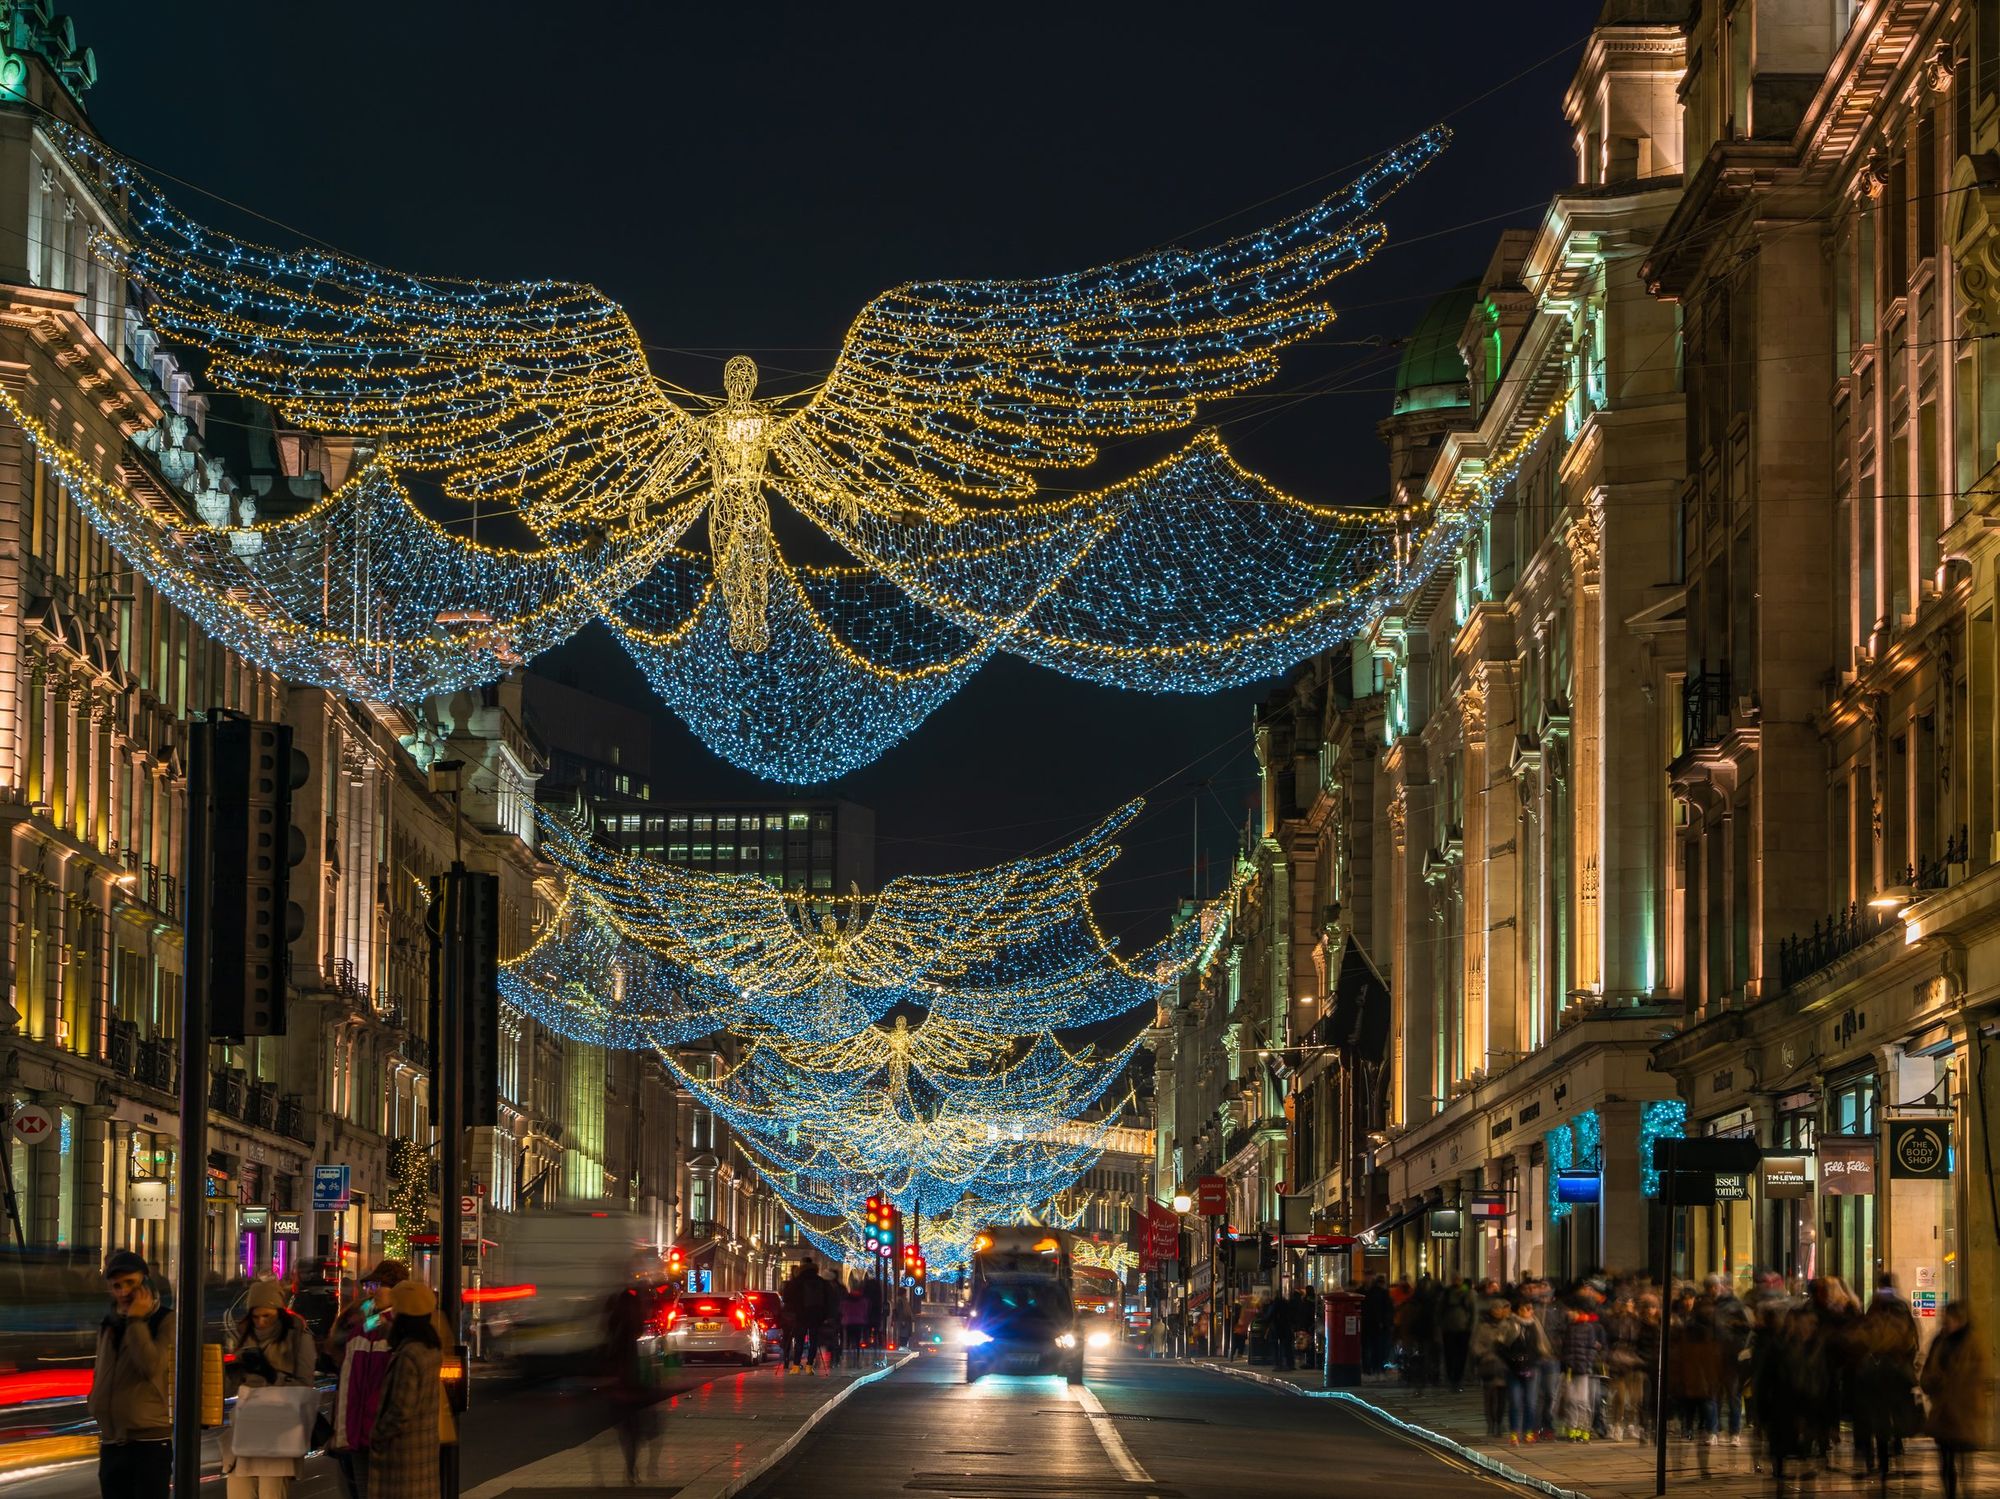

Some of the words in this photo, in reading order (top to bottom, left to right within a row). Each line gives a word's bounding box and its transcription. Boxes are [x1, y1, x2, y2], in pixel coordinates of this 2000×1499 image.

[1906, 1148, 1934, 1156] BODY
[1824, 1161, 1844, 1176] Folli
[1846, 1160, 1871, 1174] Follie
[1278, 1184, 1286, 1193] V
[274, 1221, 299, 1230] KARL
